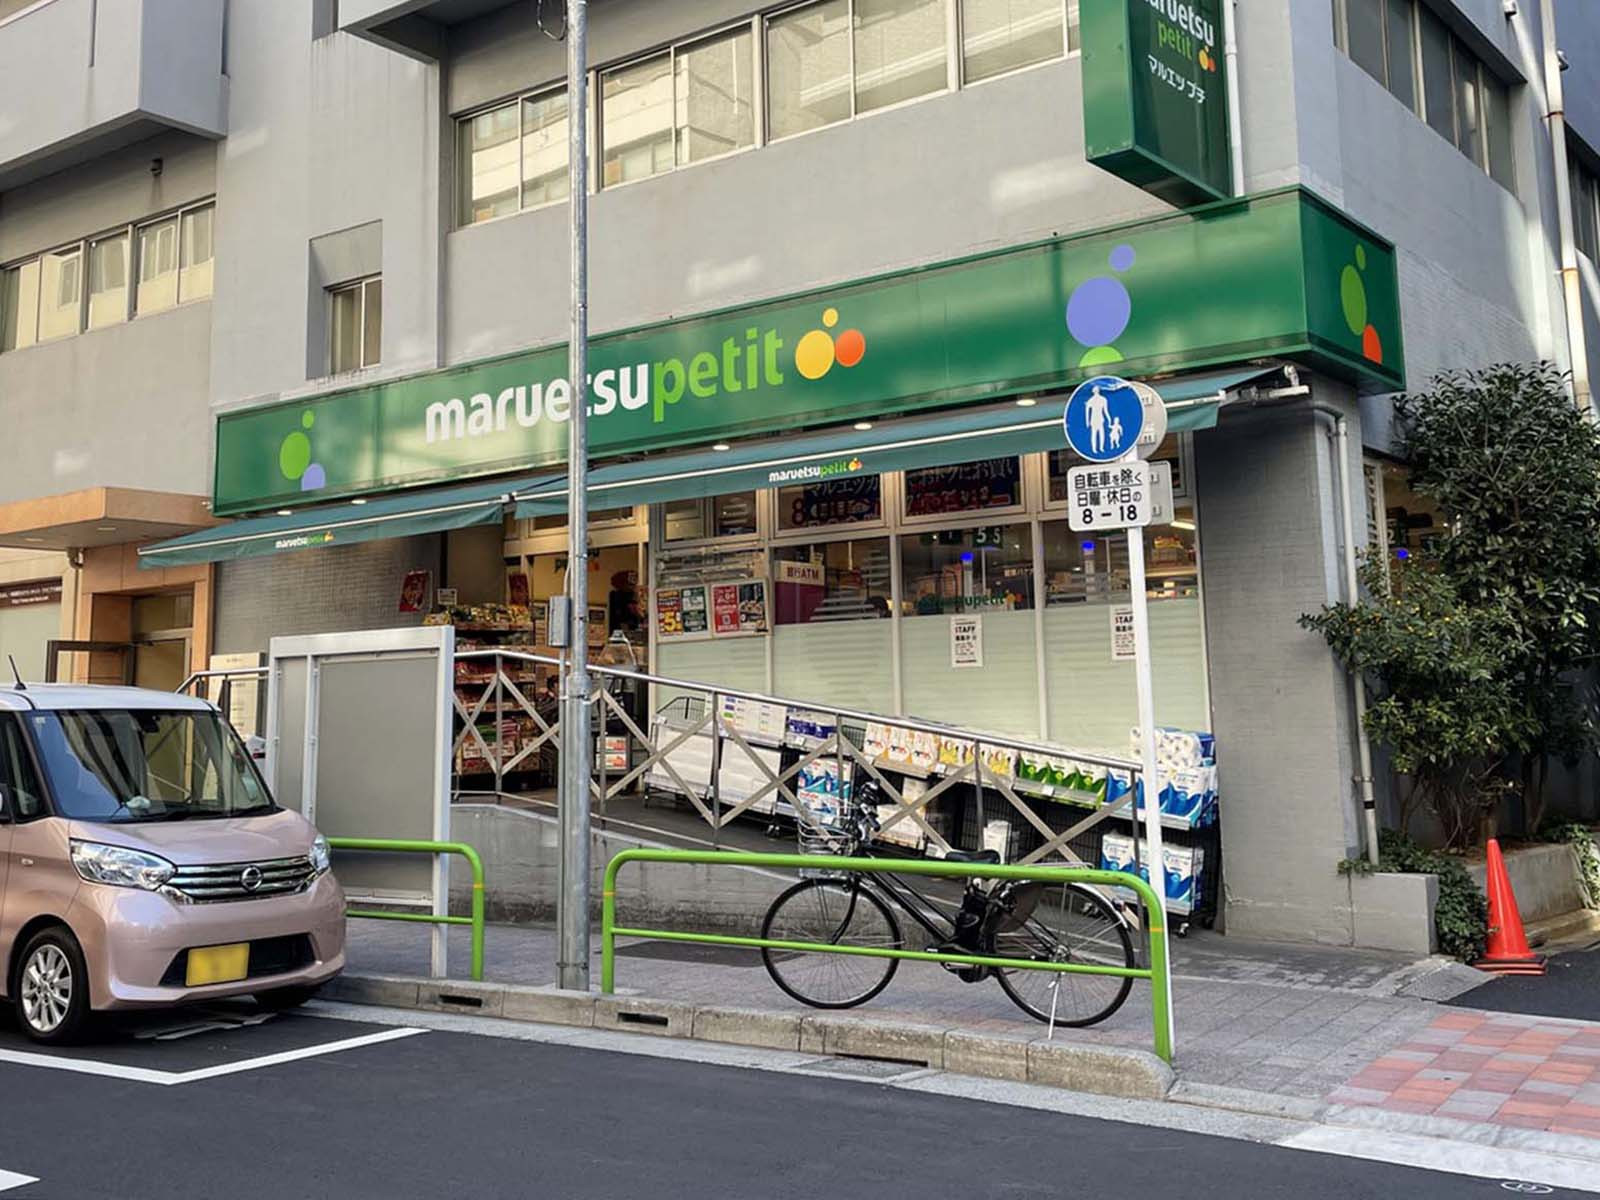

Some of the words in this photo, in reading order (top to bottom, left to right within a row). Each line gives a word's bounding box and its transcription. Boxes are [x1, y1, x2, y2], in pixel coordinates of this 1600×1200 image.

[1145, 0, 1214, 47] aruetsu
[1157, 20, 1193, 61] petit
[1147, 54, 1185, 91] マルエツ
[1074, 468, 1143, 489] 自転車を除く
